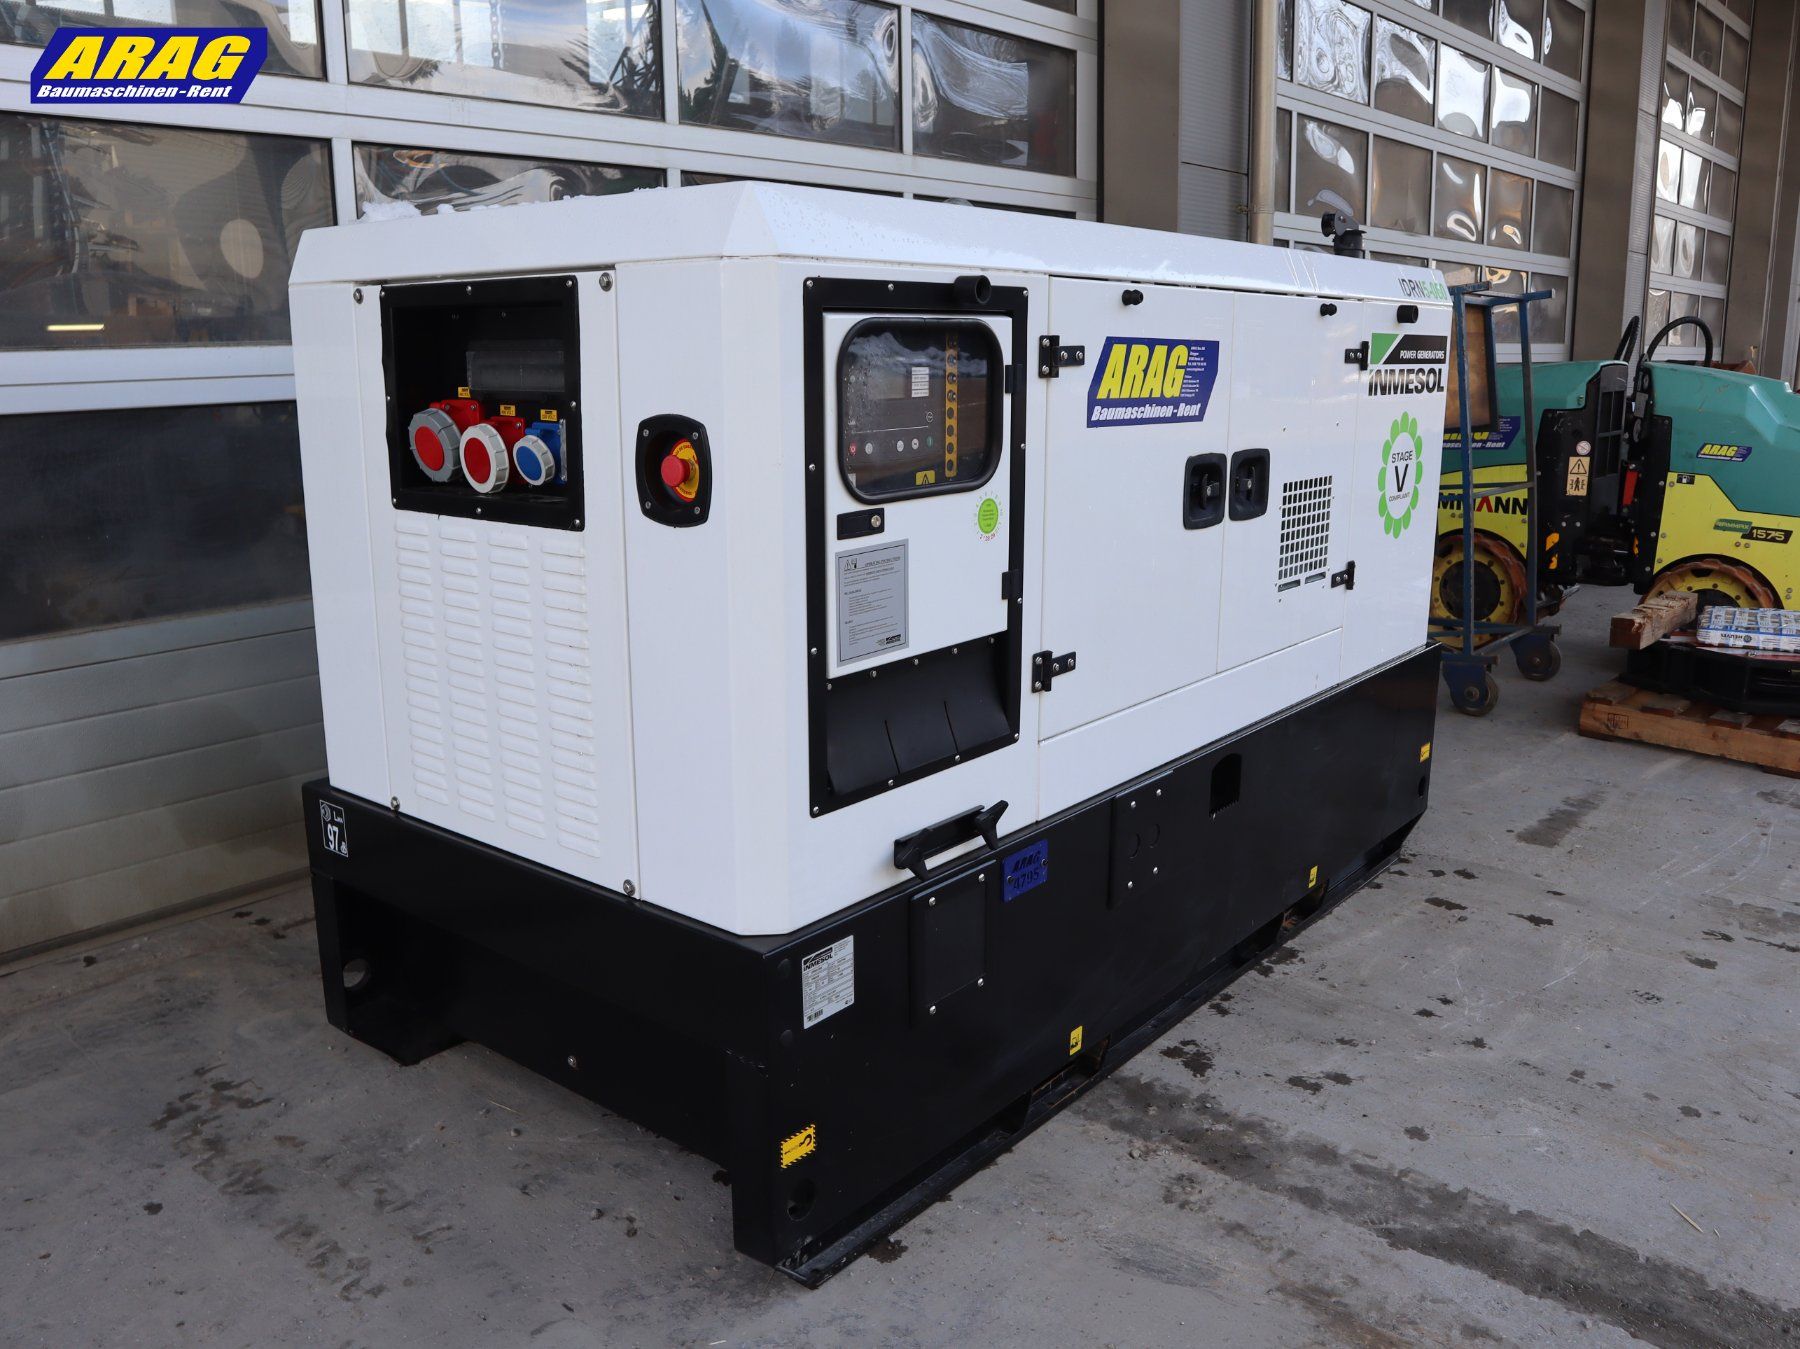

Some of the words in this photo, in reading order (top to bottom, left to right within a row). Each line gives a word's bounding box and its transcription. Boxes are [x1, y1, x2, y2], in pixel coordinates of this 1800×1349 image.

[1400, 350, 1417, 359] POWER
[1417, 350, 1445, 359] GENERATORS
[1096, 344, 1188, 399] ARAG
[1368, 367, 1444, 396] INMESOL
[1091, 403, 1201, 421] Baumaschinen-Rent
[1391, 450, 1413, 463] STAGE
[1700, 444, 1738, 457] ARAG
[1394, 463, 1409, 492] V
[1752, 528, 1785, 541] 1575
